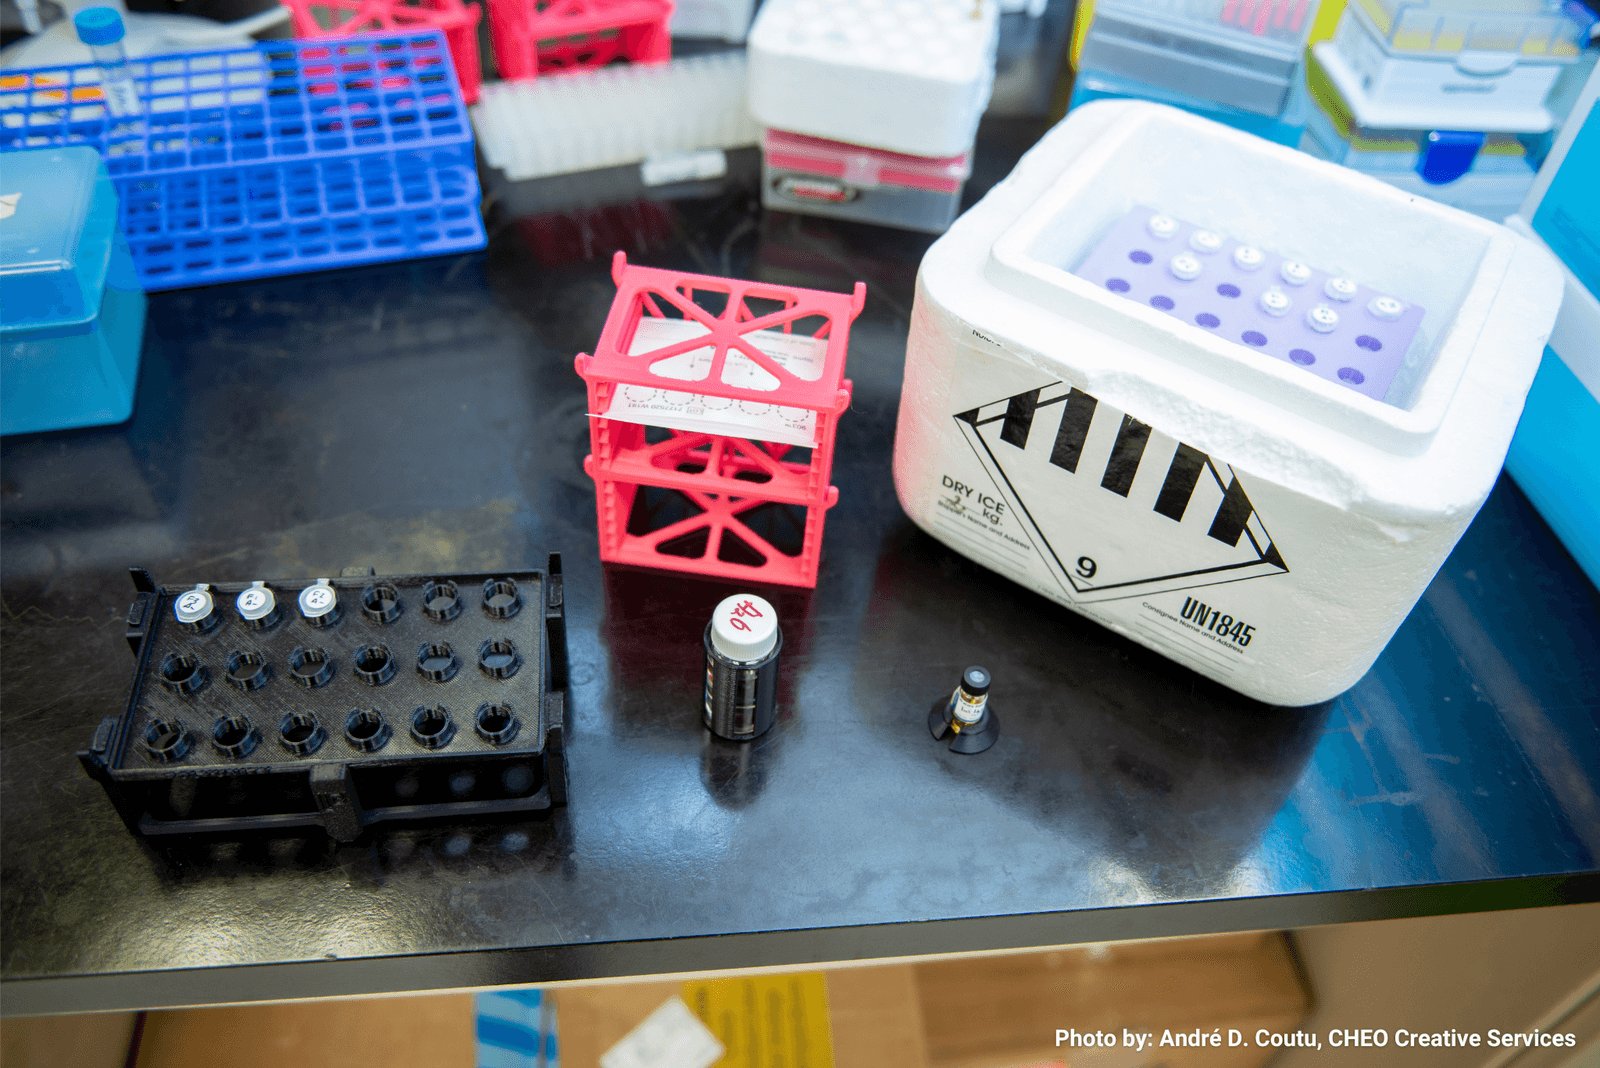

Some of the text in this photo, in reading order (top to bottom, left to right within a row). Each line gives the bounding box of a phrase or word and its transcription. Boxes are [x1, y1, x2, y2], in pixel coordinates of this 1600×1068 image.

[942, 475, 1005, 516] DRY ICE
[968, 515, 987, 528] Name
[989, 527, 1003, 537] and
[1004, 534, 1031, 550] Address
[983, 508, 1003, 528] kg.
[1075, 556, 1097, 579] 9
[1142, 602, 1244, 654] Consignee Name and Address
[1180, 596, 1257, 647] UN1845
